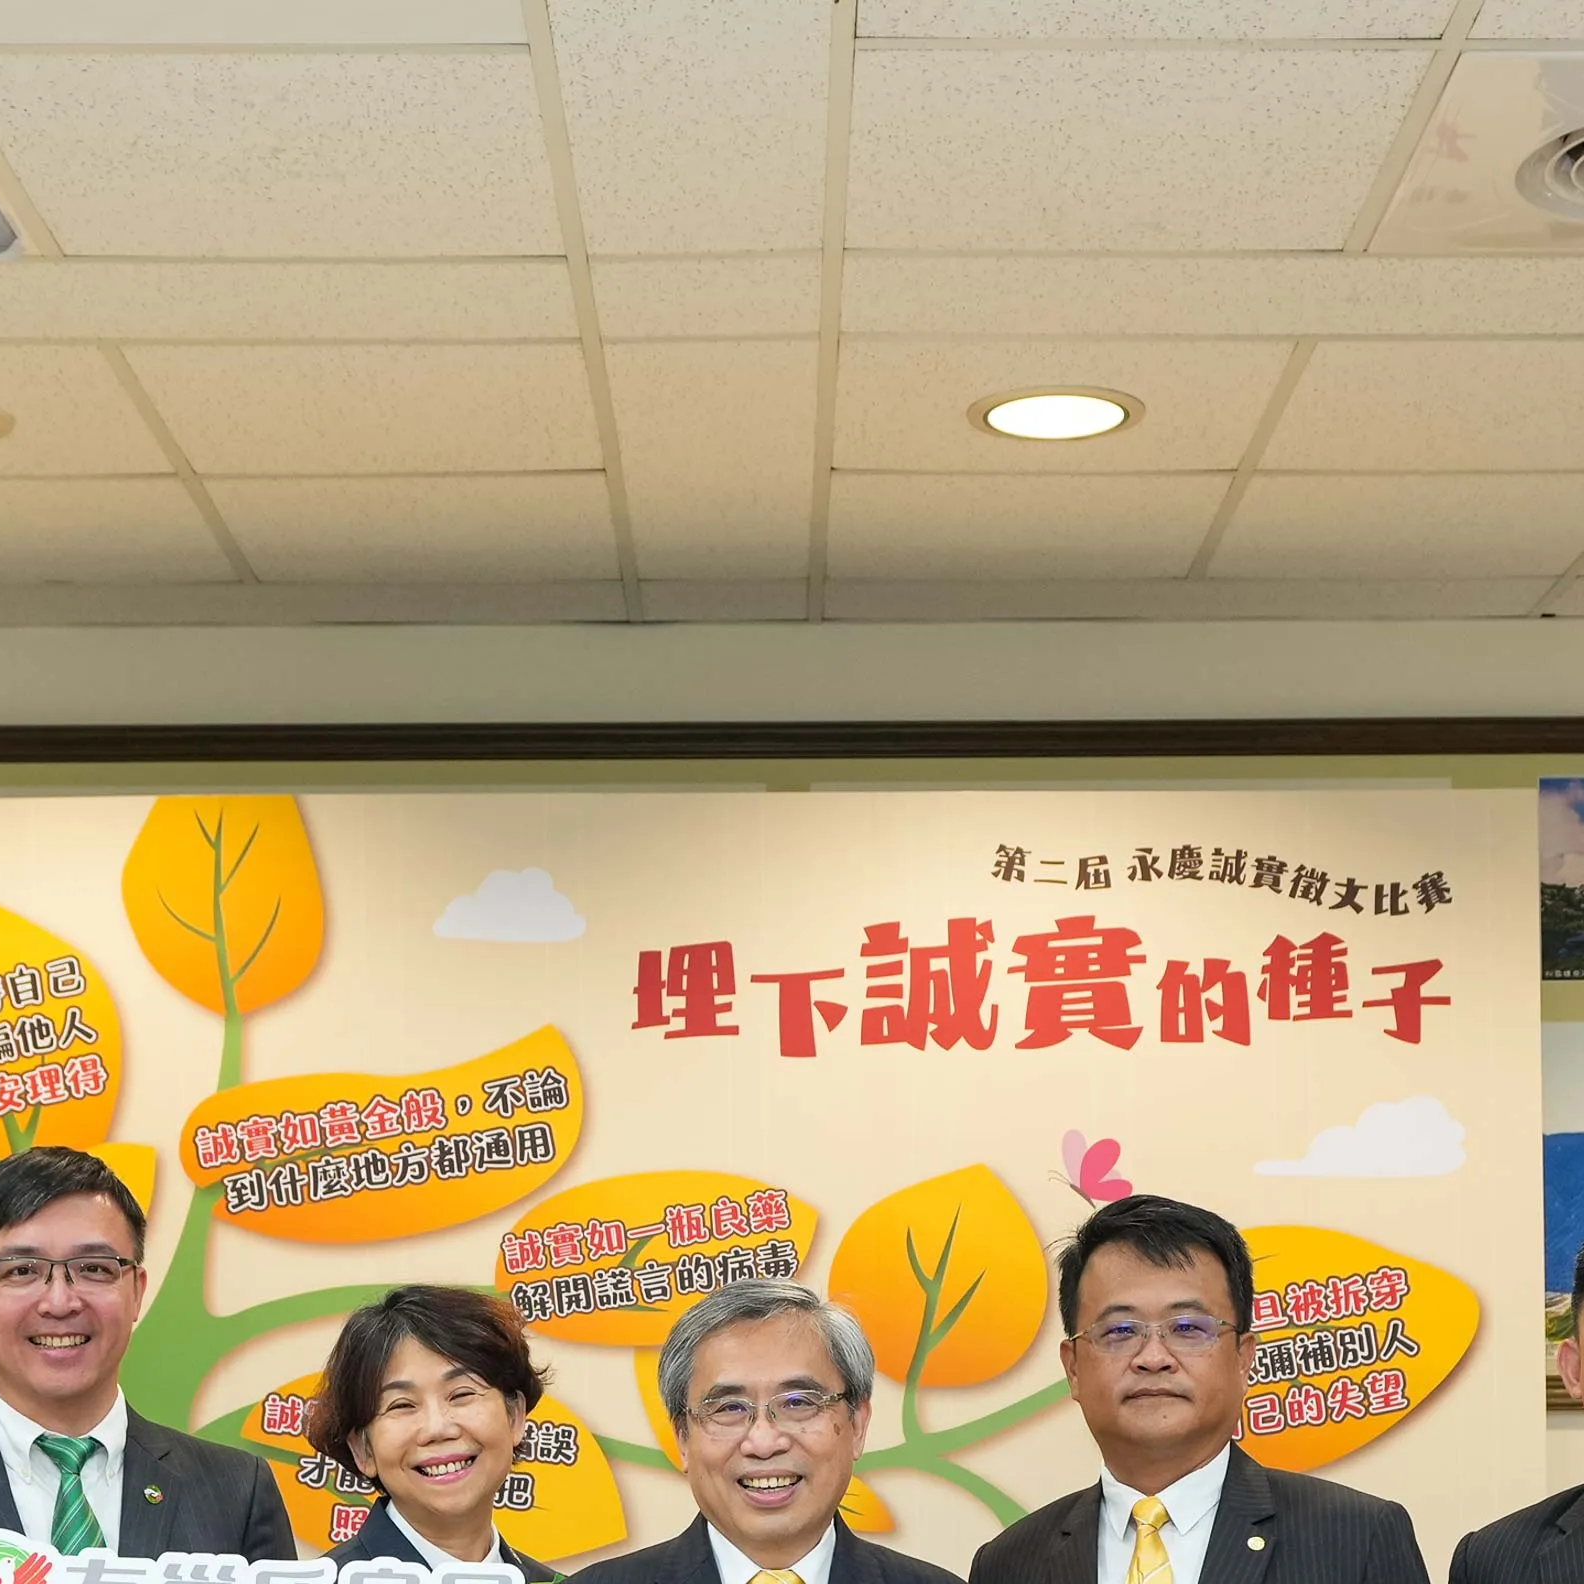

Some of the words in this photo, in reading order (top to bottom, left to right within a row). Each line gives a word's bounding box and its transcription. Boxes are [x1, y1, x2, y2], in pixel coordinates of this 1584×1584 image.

[990, 843, 1113, 892] 第二屆
[1126, 844, 1454, 917] 永慶誠實徵文比賽
[631, 914, 1453, 1059] 埋下誠實的種子
[224, 1124, 555, 1213] 到什麼地方都通用
[503, 1190, 790, 1272] 誠實如一瓶良藥
[1248, 1321, 1419, 1384] 彌補別人
[1232, 1371, 1408, 1440] 己的失望
